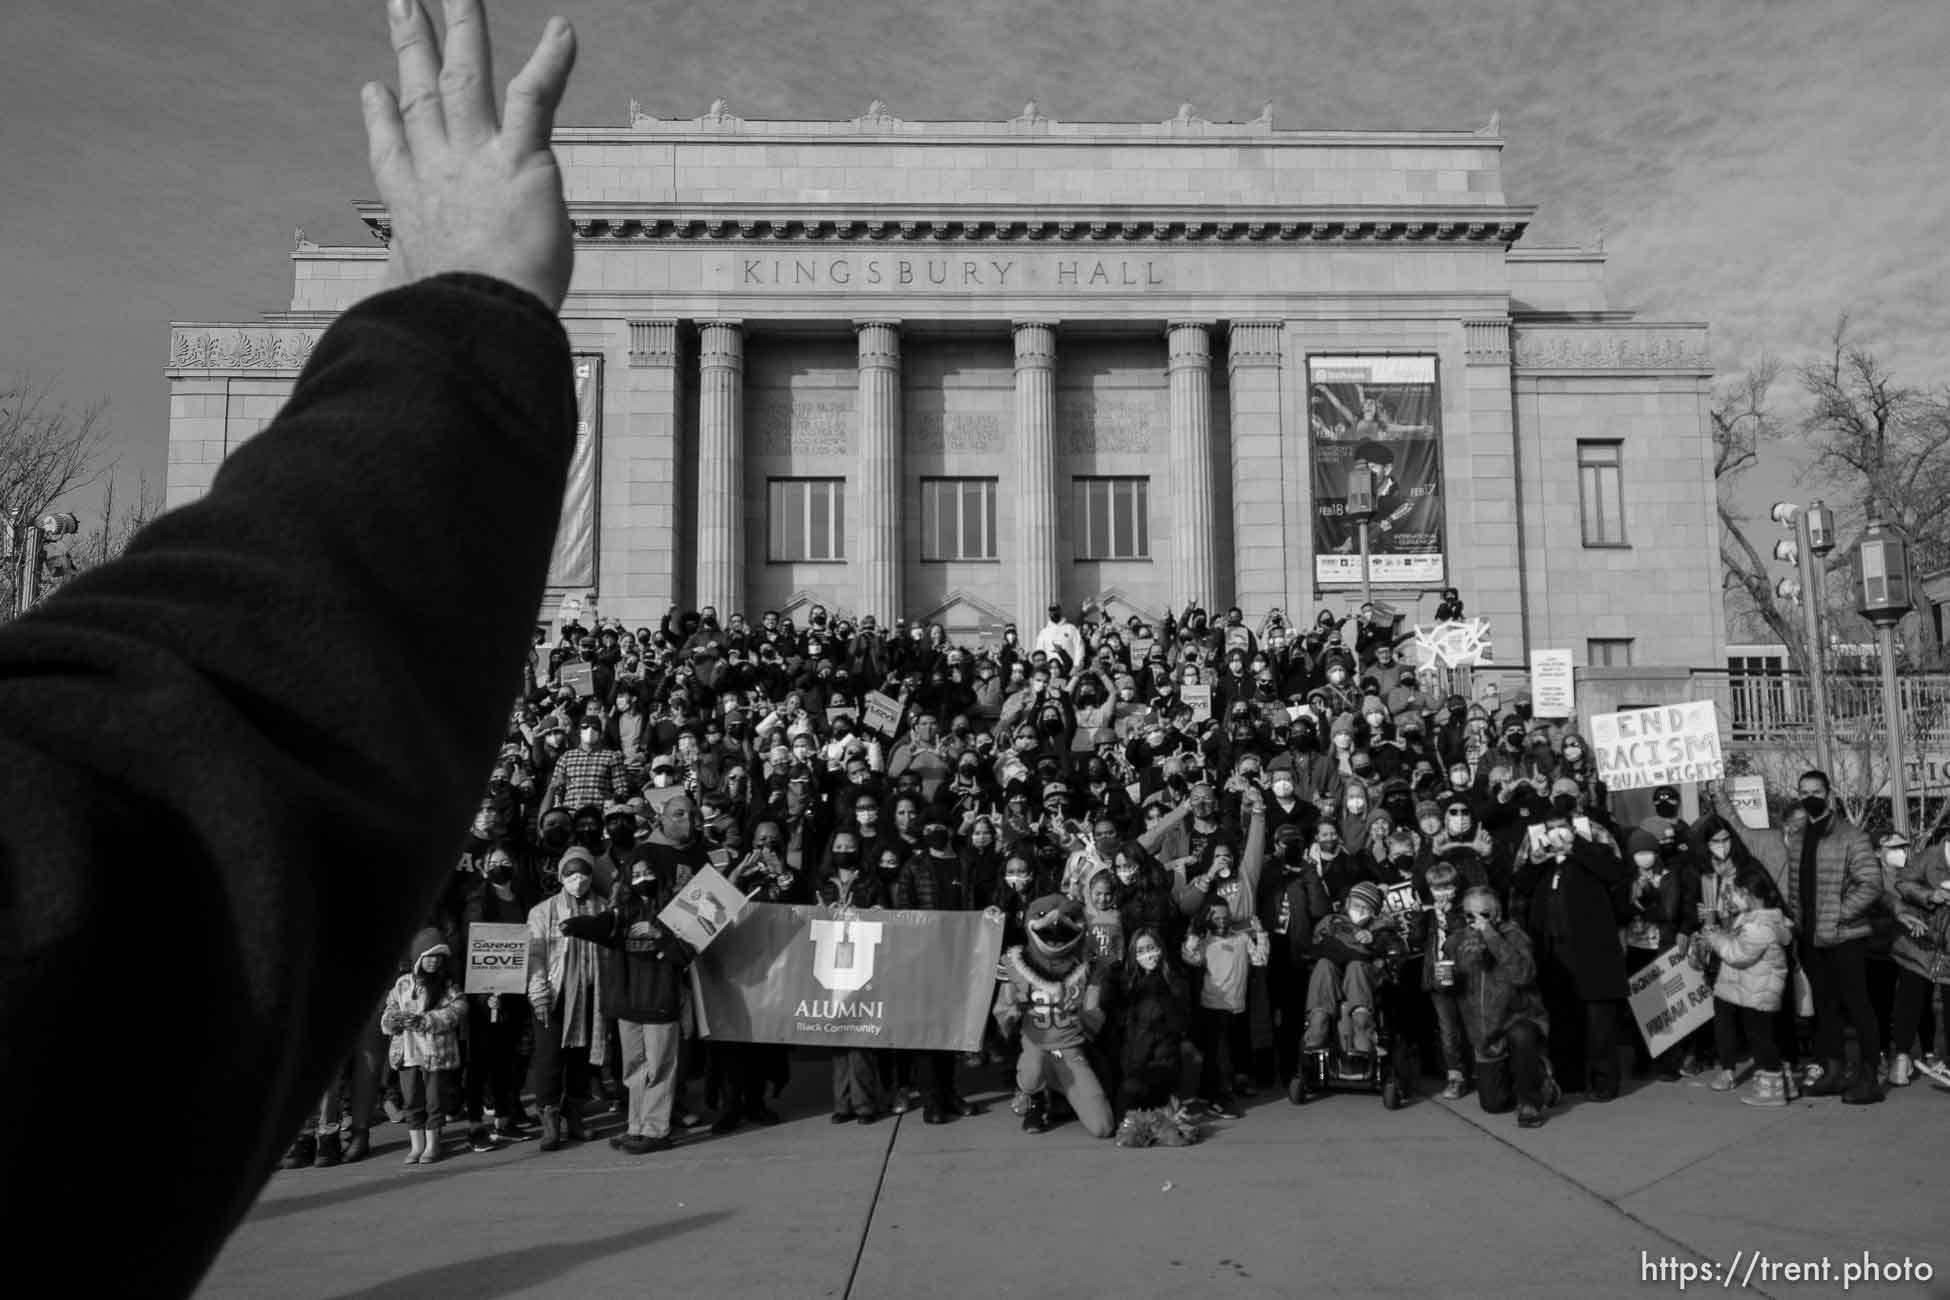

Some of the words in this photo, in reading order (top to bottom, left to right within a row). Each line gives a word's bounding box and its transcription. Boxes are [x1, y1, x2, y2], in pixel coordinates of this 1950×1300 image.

[744, 261, 1013, 284] KINGSBURY
[1058, 261, 1162, 284] HALL
[1617, 708, 1683, 738] END
[1597, 734, 1719, 769] RACISM
[1666, 760, 1722, 784] RIGHTS
[472, 955, 524, 965] LOVE
[809, 919, 883, 991] U
[794, 1000, 883, 1018] ALUMNI
[796, 1022, 821, 1032] Black
[824, 1022, 881, 1035] Community
